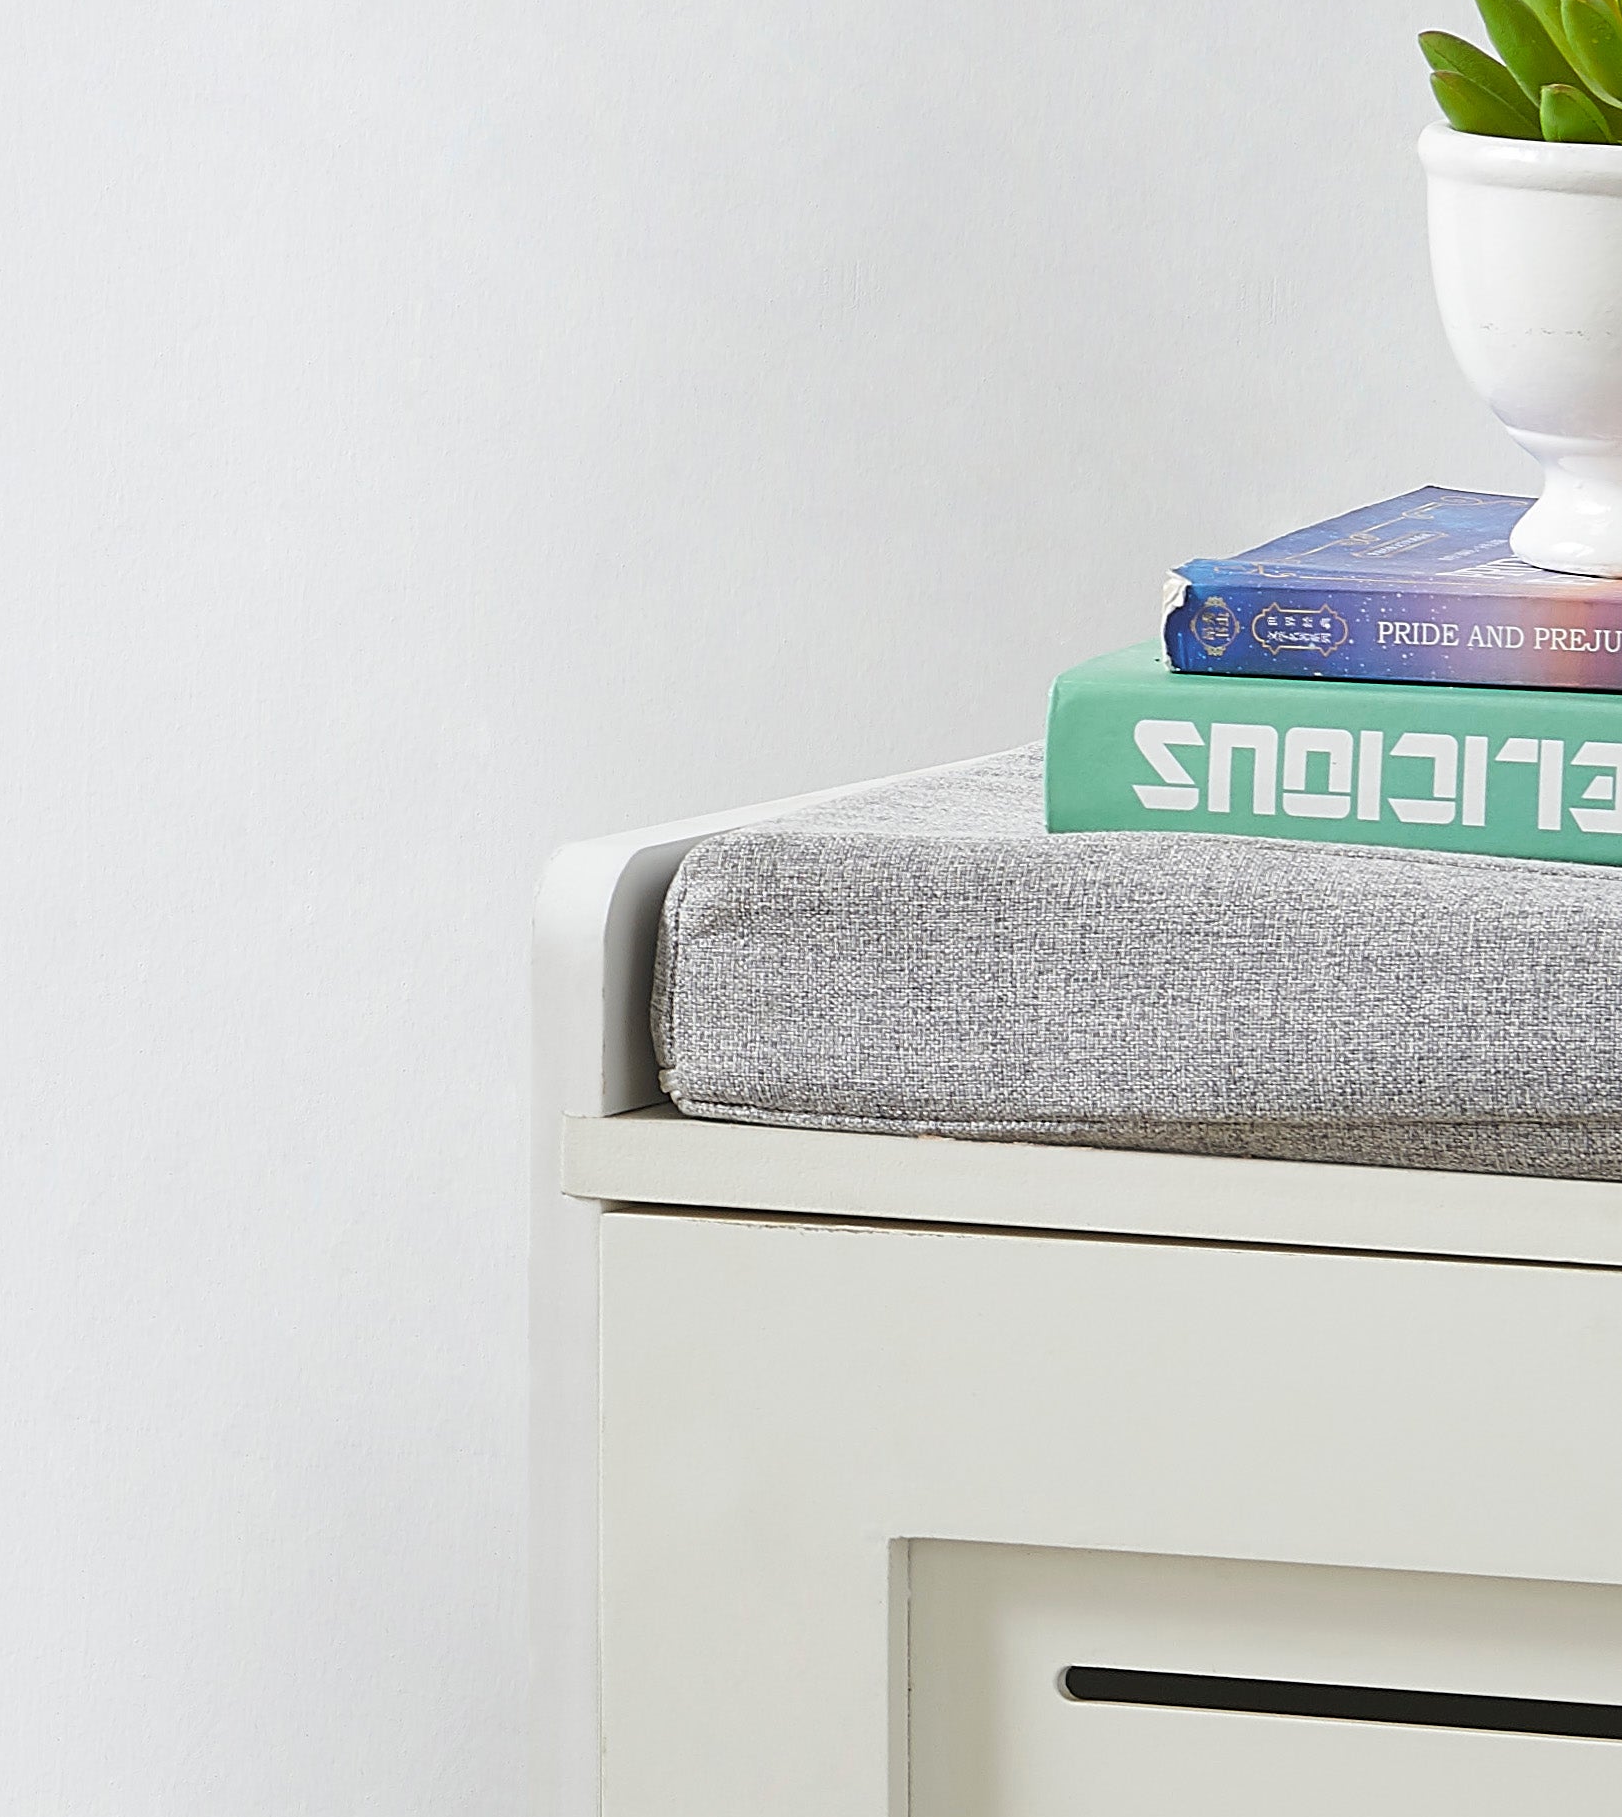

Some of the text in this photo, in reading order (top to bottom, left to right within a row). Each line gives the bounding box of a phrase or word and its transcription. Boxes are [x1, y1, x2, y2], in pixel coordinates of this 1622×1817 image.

[1377, 620, 1622, 653] PRIDE AND PREJU
